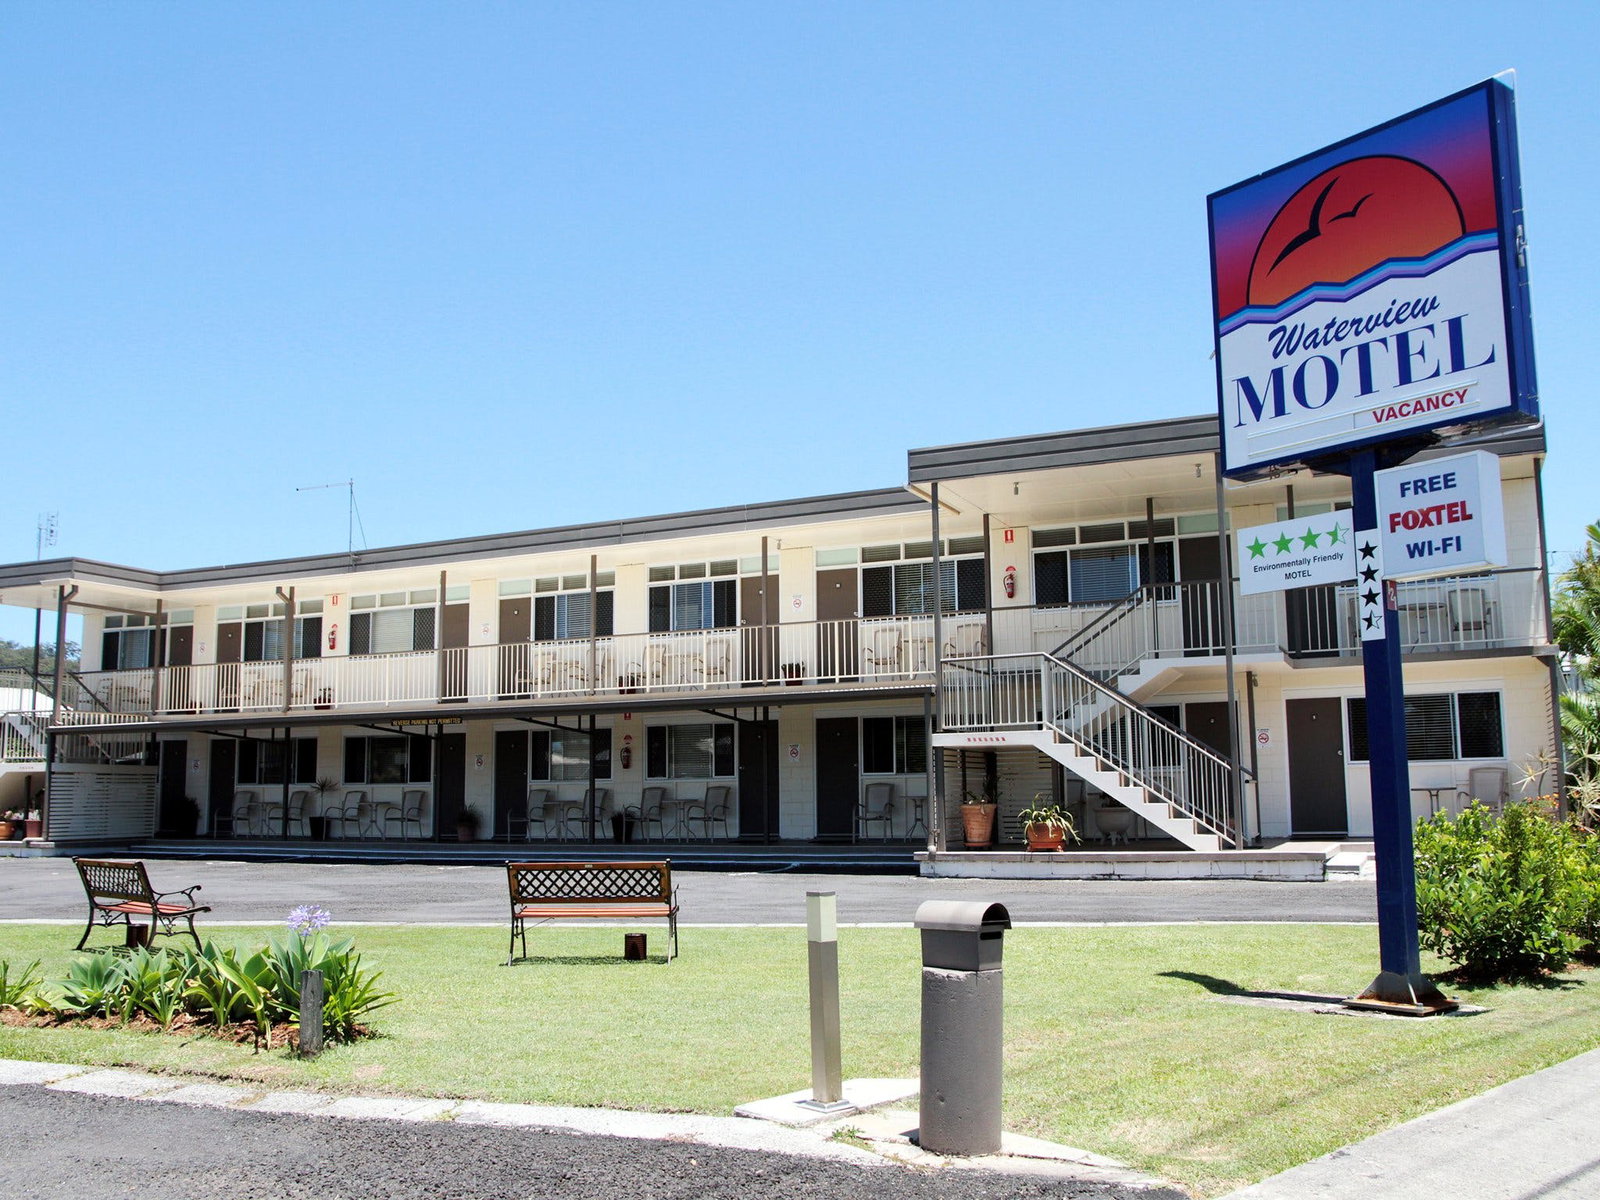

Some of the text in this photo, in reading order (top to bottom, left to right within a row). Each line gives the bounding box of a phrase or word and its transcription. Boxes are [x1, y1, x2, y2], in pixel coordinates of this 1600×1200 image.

[1268, 295, 1440, 360] Waterview
[1231, 314, 1496, 428] MOTEL
[1373, 389, 1468, 424] VACANCY
[1400, 472, 1457, 498] FREE
[1389, 500, 1473, 533] FOXTEL
[1406, 535, 1462, 560] WI-FI
[1253, 552, 1344, 573] Environmentally Friendly
[1284, 569, 1312, 581] MOTEL
